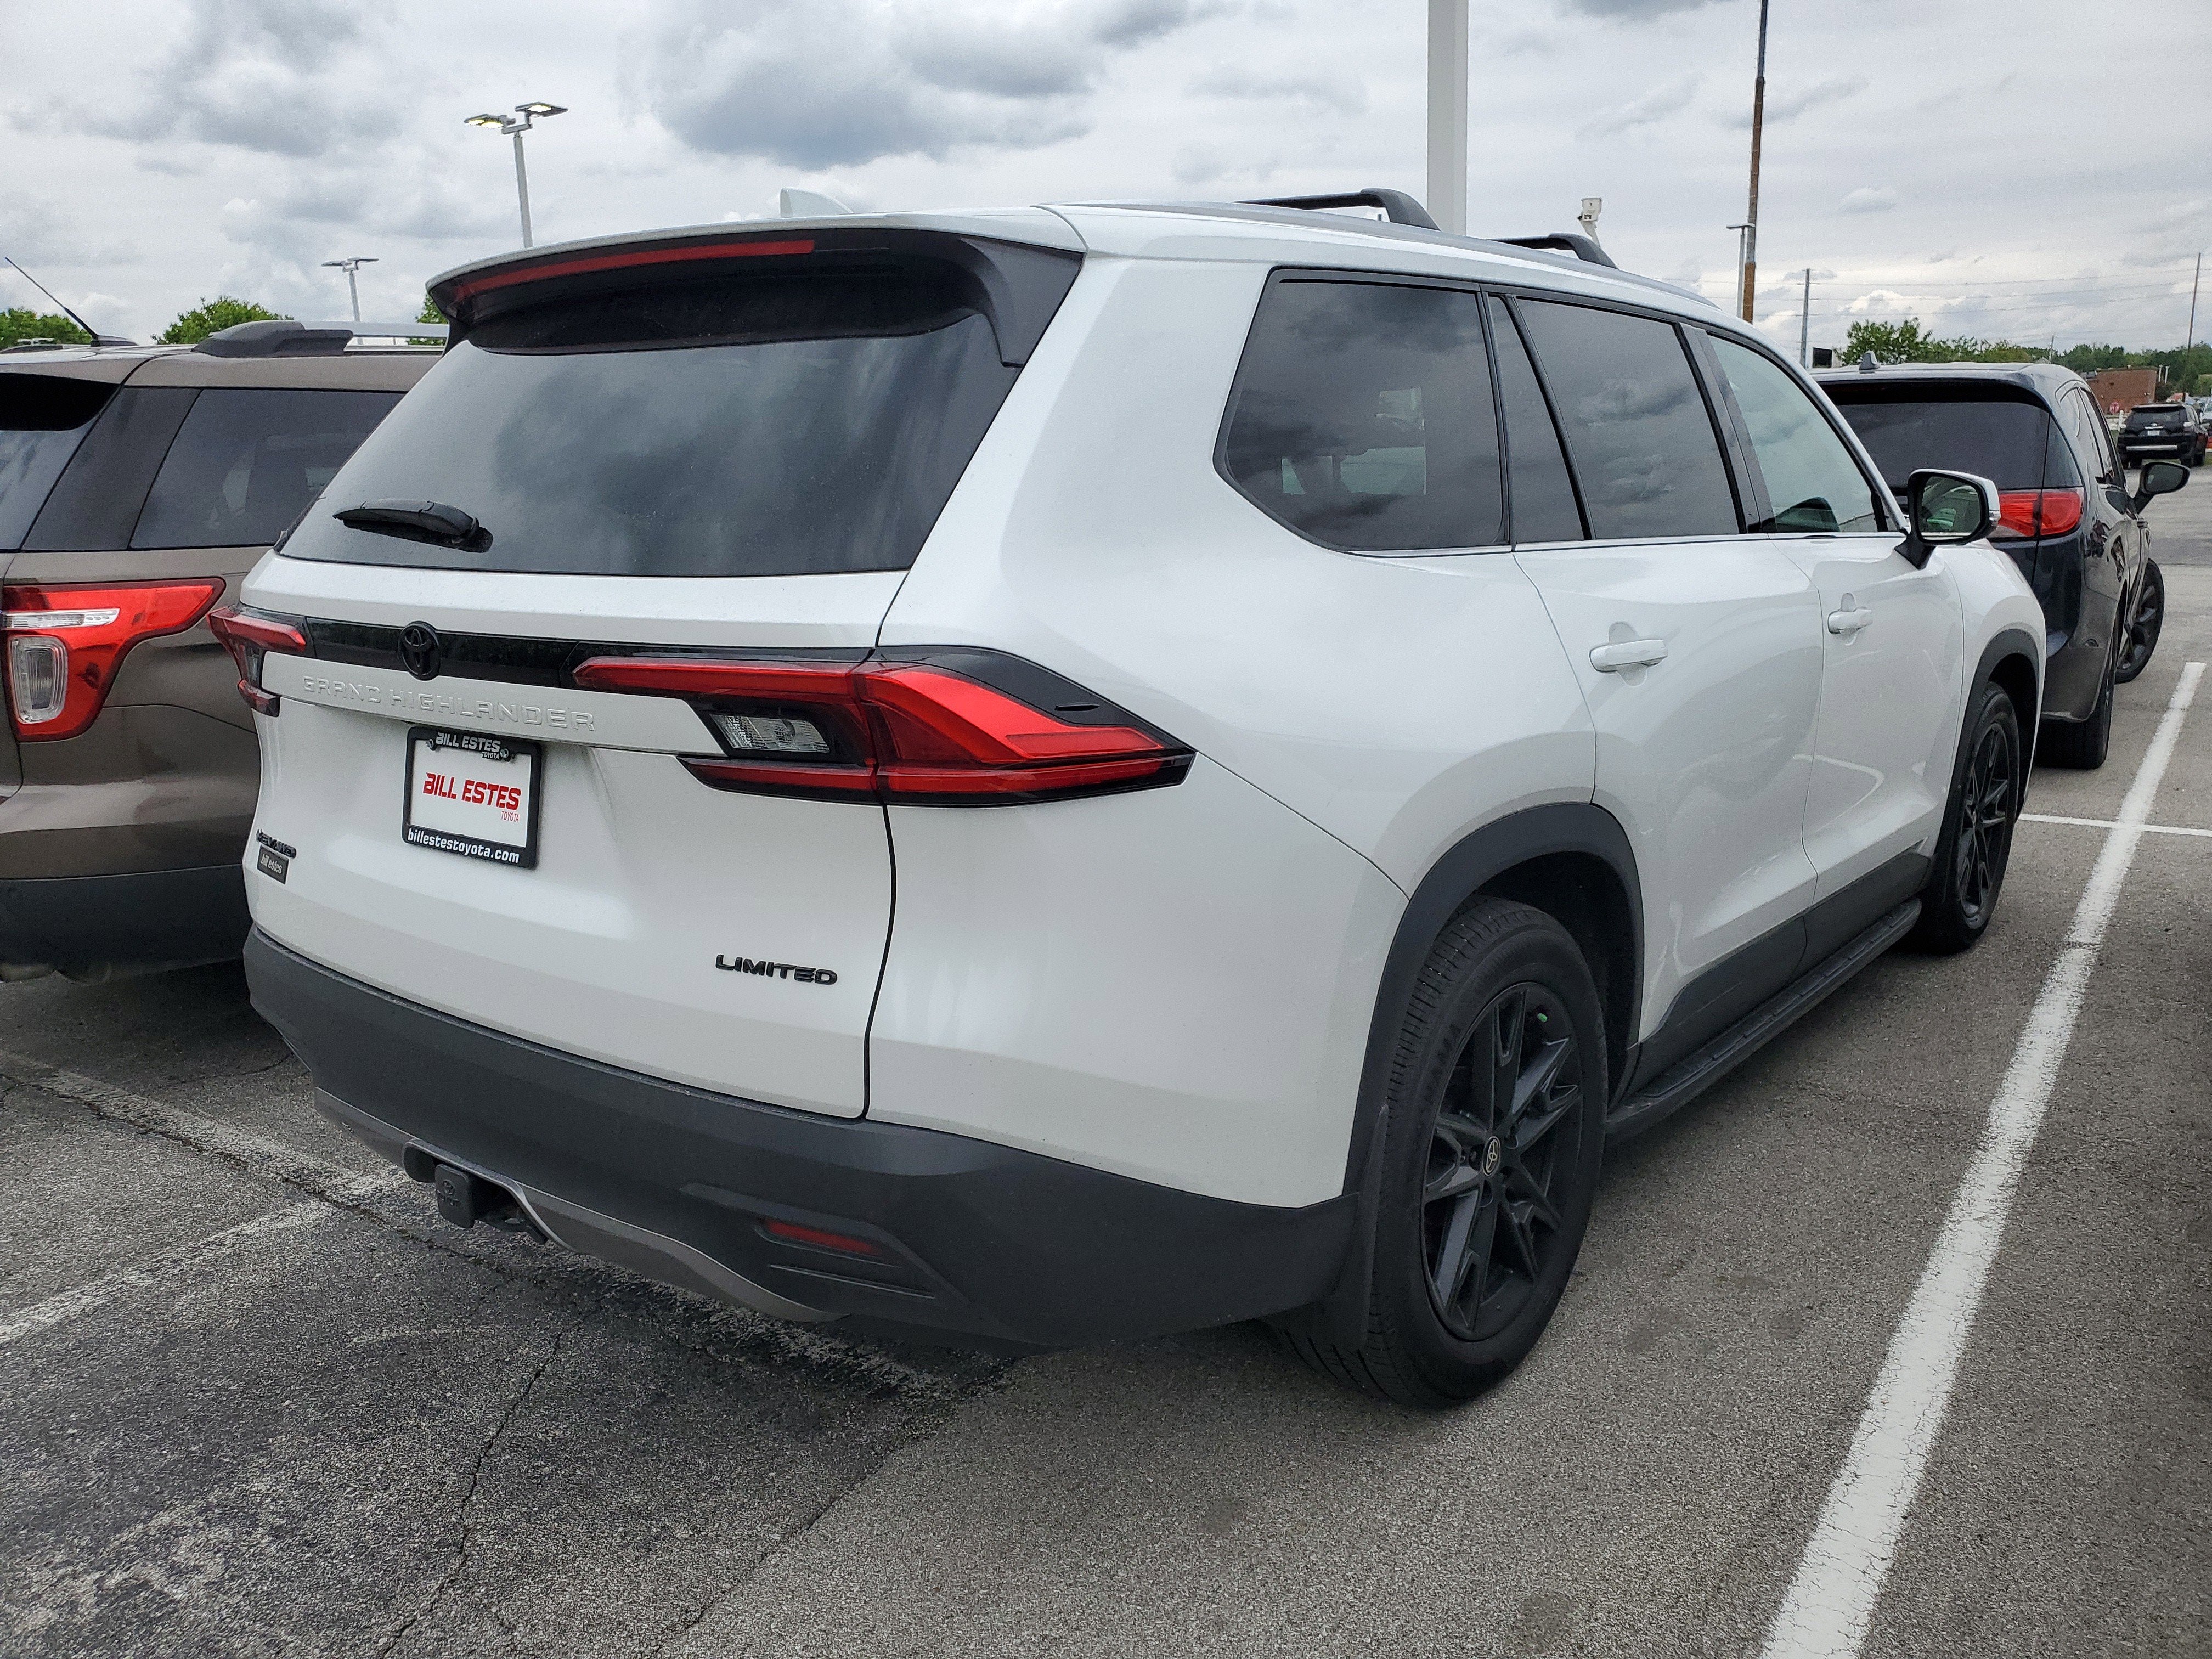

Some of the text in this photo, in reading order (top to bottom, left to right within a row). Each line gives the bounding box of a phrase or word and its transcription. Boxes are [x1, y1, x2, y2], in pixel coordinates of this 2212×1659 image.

[303, 676, 595, 731] GRAND HIGHLANDER
[435, 732, 501, 753] BILL ESTES
[423, 772, 521, 810] BILL ESTES
[501, 810, 519, 822] TOYOTA
[407, 828, 520, 863] billestestoyota.com
[715, 955, 838, 985] LIMITED
